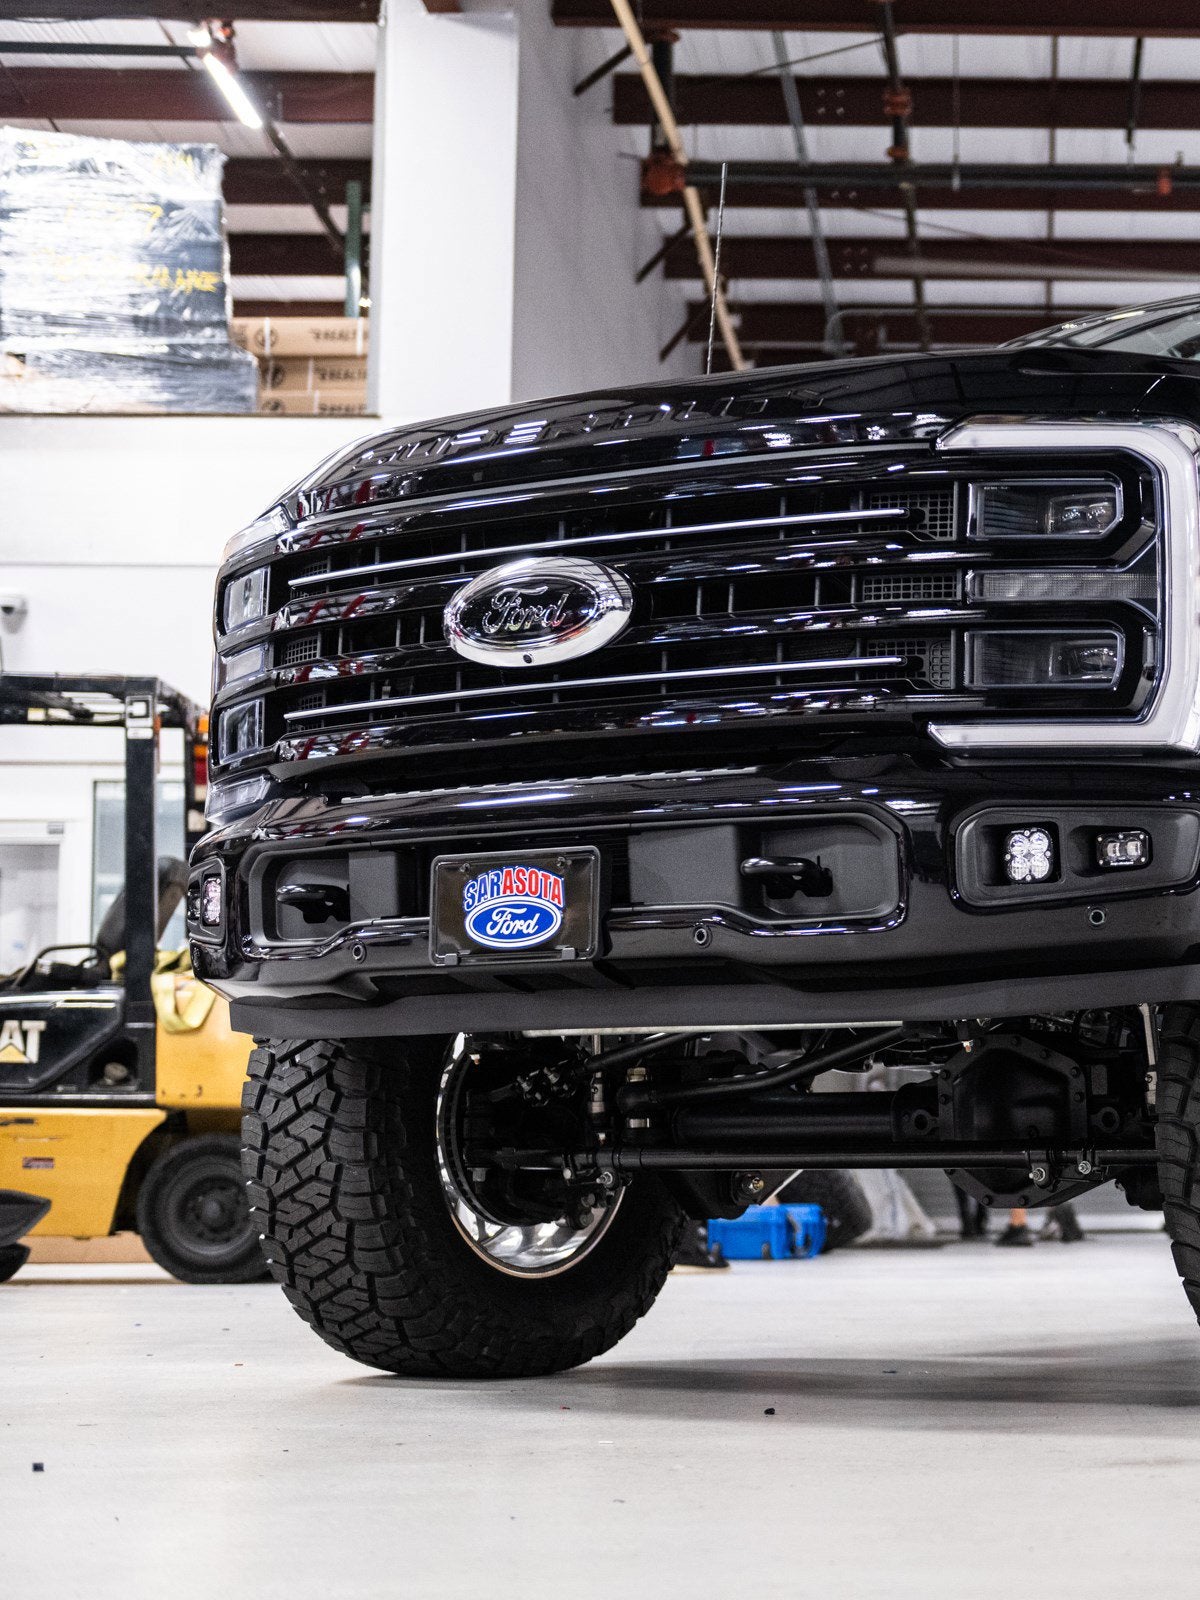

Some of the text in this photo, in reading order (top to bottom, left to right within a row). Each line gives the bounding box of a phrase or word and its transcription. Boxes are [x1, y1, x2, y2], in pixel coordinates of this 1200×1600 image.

[481, 584, 570, 635] Ford
[464, 866, 564, 912] SARASOTA
[485, 906, 541, 936] Ford
